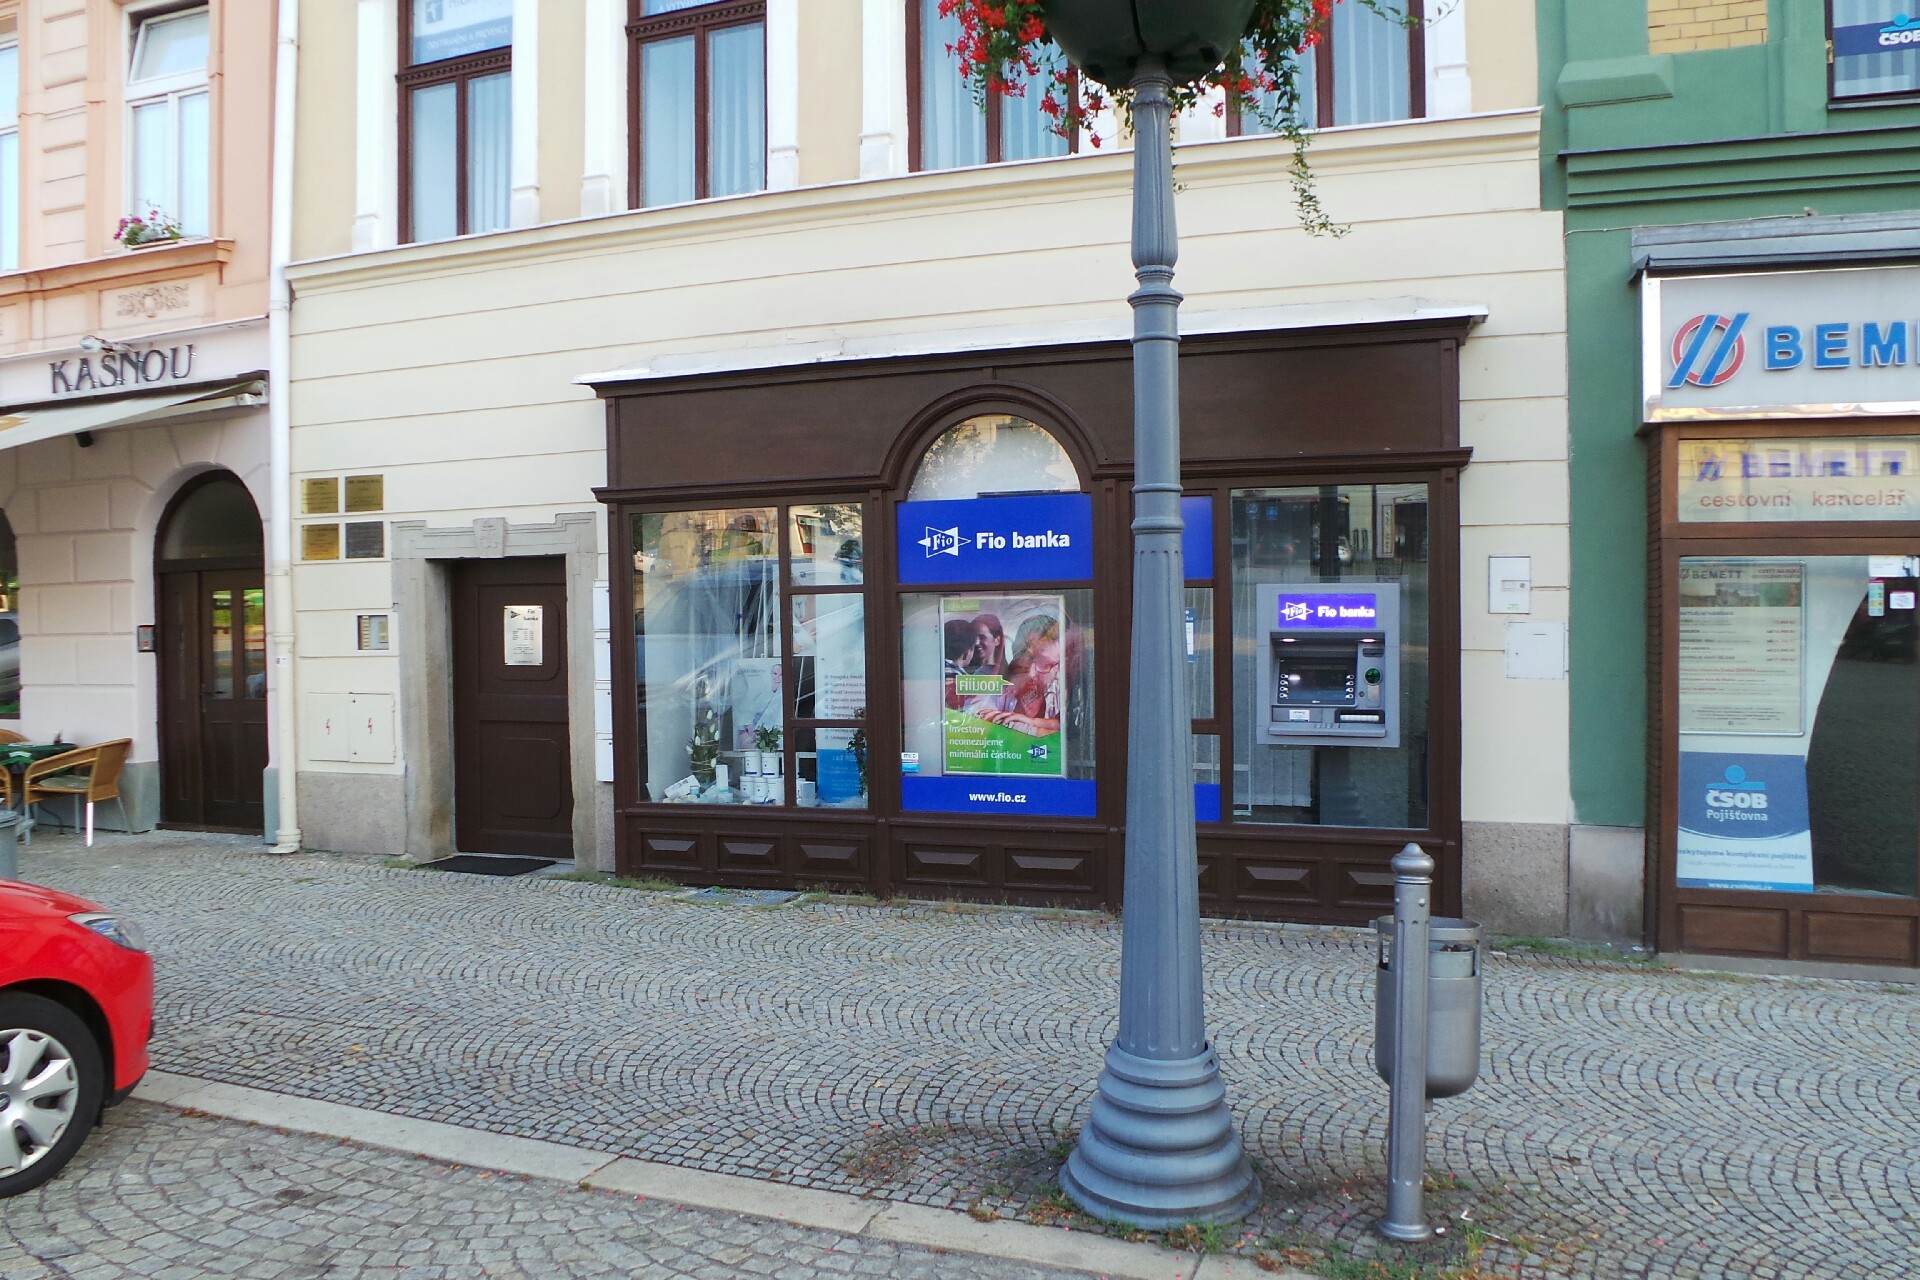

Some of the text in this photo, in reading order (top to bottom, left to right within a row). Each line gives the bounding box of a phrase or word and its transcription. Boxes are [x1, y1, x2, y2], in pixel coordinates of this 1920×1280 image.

[1764, 320, 1920, 370] BEM
[1700, 490, 1906, 508] cestovní kancelář
[932, 530, 1070, 551] Fio Fio banka
[1317, 606, 1337, 618] Fio
[1340, 606, 1375, 618] banka
[949, 738, 1004, 749] neomezujeme
[949, 750, 1022, 760] minimální částkou
[968, 792, 1027, 803] www.fio.cz
[1706, 790, 1768, 808] ČSOB
[1706, 809, 1768, 822] Pojišťovna
